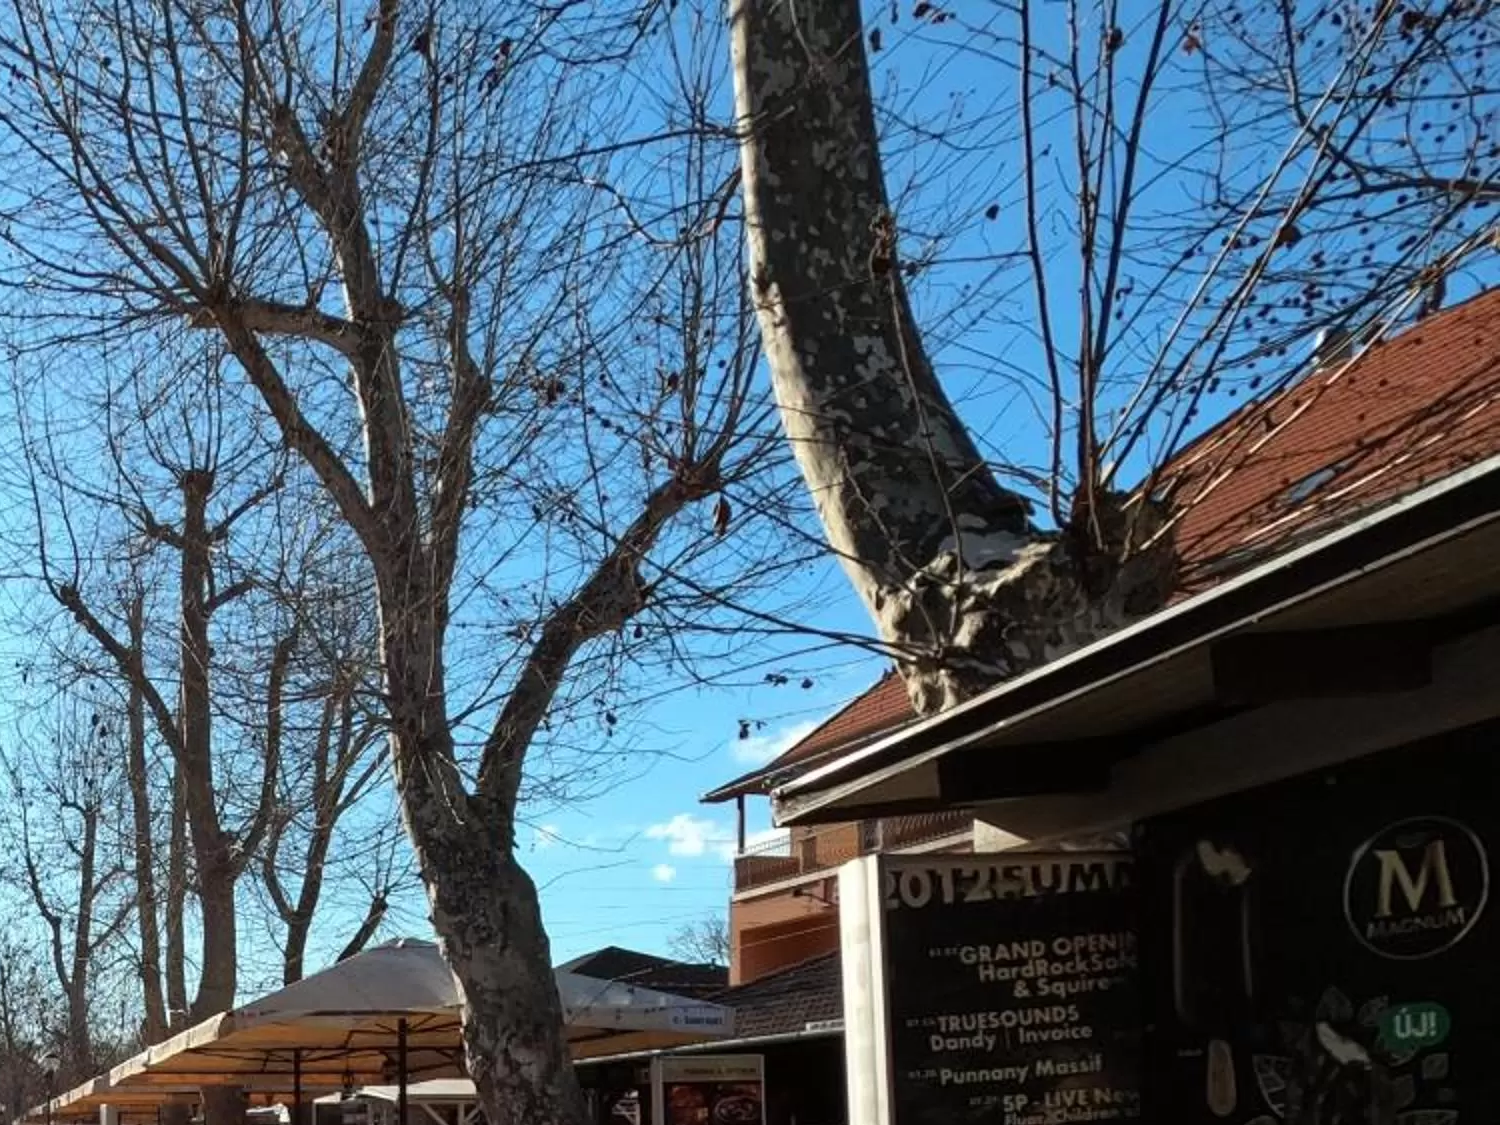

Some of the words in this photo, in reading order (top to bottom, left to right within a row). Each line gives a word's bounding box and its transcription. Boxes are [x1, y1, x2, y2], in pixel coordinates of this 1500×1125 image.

[1373, 838, 1458, 918] M
[960, 939, 1045, 965] GRAND
[936, 1004, 1080, 1033] TRUESOUNDS
[1393, 1008, 1437, 1038] ÚJ!
[930, 1033, 996, 1052] Dandy
[1018, 1025, 1093, 1044] Invoice
[939, 1064, 1029, 1086] Punnany
[1035, 1052, 1103, 1077] Massif
[1002, 1093, 1029, 1113] SP
[1044, 1089, 1089, 1107] LIVE
